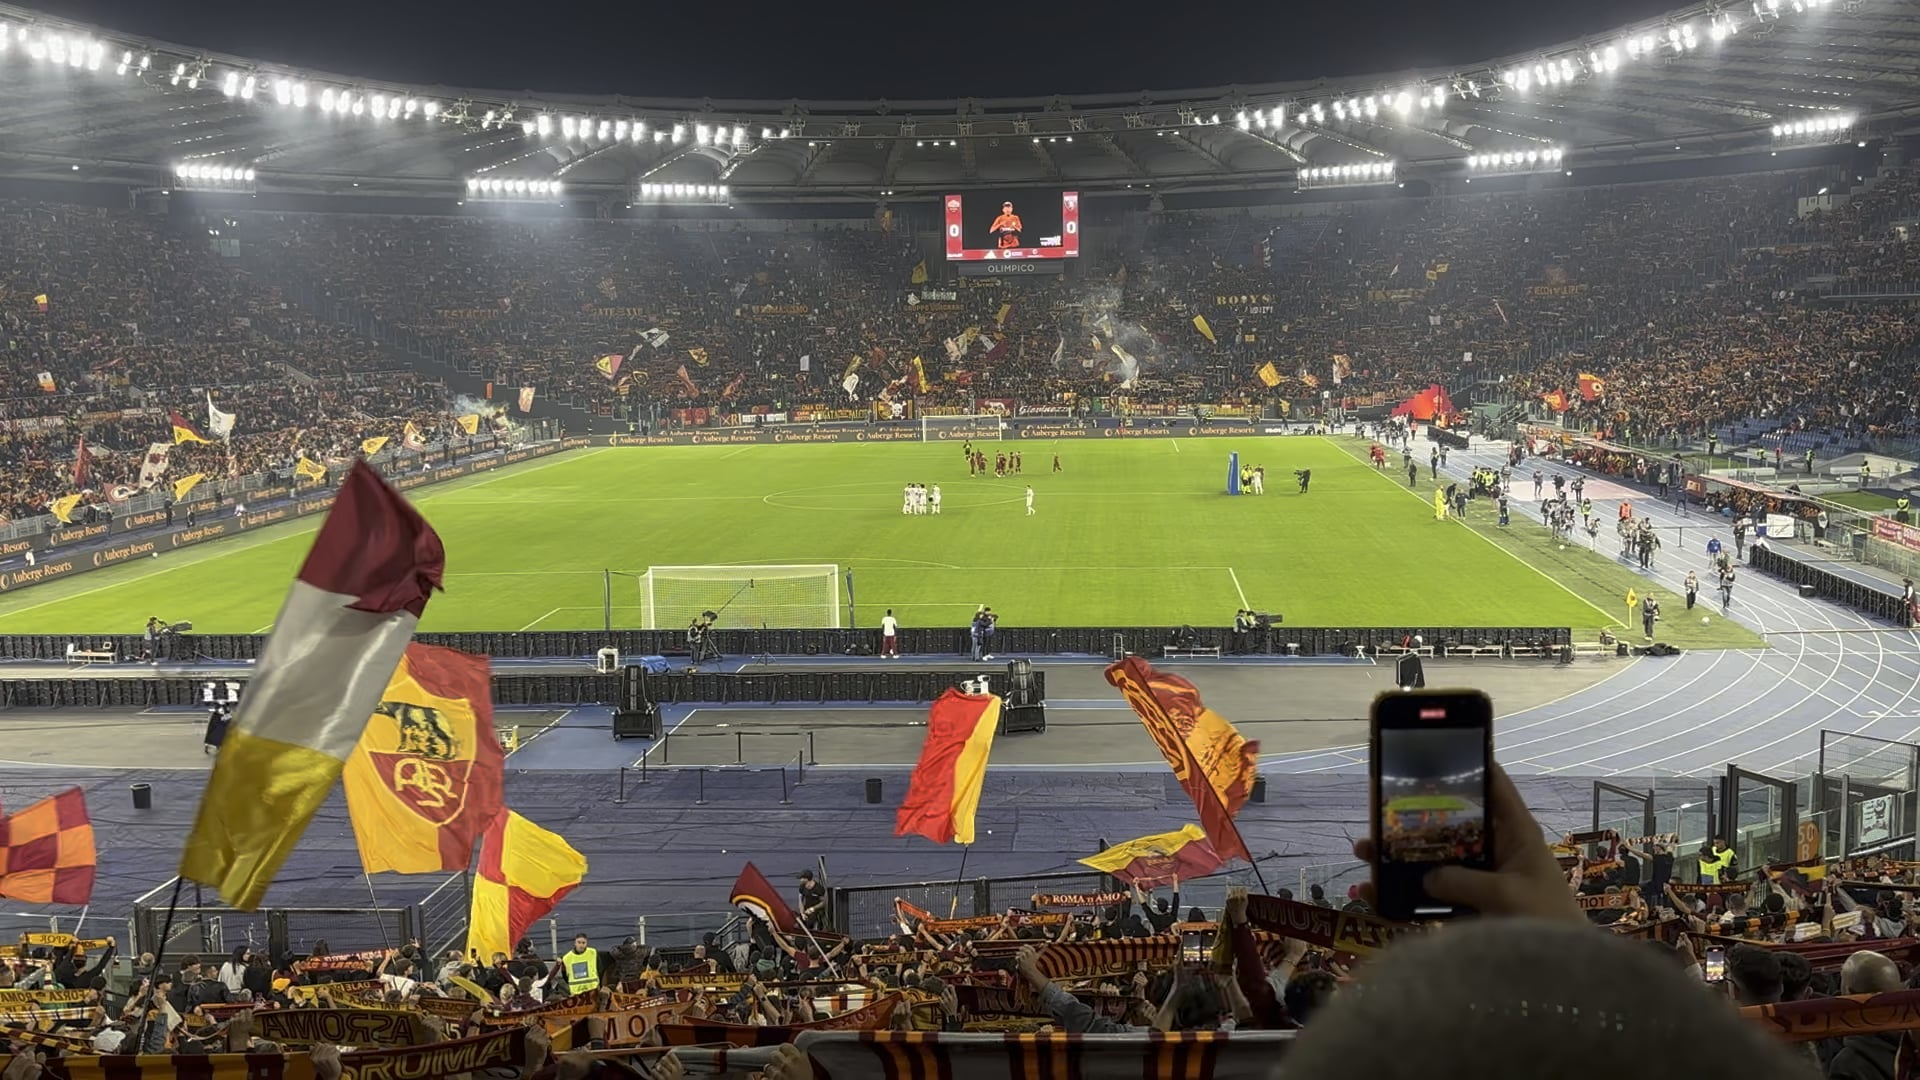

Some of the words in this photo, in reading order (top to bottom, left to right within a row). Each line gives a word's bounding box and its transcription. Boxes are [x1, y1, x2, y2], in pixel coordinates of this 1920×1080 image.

[949, 224, 960, 237] 0
[1066, 221, 1077, 234] 0
[987, 264, 1035, 273] OLIMPICO
[866, 432, 894, 440] Auberge
[1199, 427, 1228, 435] Auberge
[1228, 426, 1255, 434] Resorts
[619, 436, 646, 445] Auberge
[647, 436, 673, 444] Resorts
[702, 435, 730, 443] Auberge
[784, 433, 812, 441] Auberge
[59, 530, 85, 542] Auberge
[85, 524, 108, 537] Resorts
[3, 541, 31, 554] Resorts
[103, 548, 130, 562] Auberge
[130, 541, 154, 555] Resorts
[12, 569, 43, 585] Auberge
[44, 562, 73, 577] Resorts
[1052, 893, 1086, 904] ROMA
[1095, 892, 1121, 902] AMO
